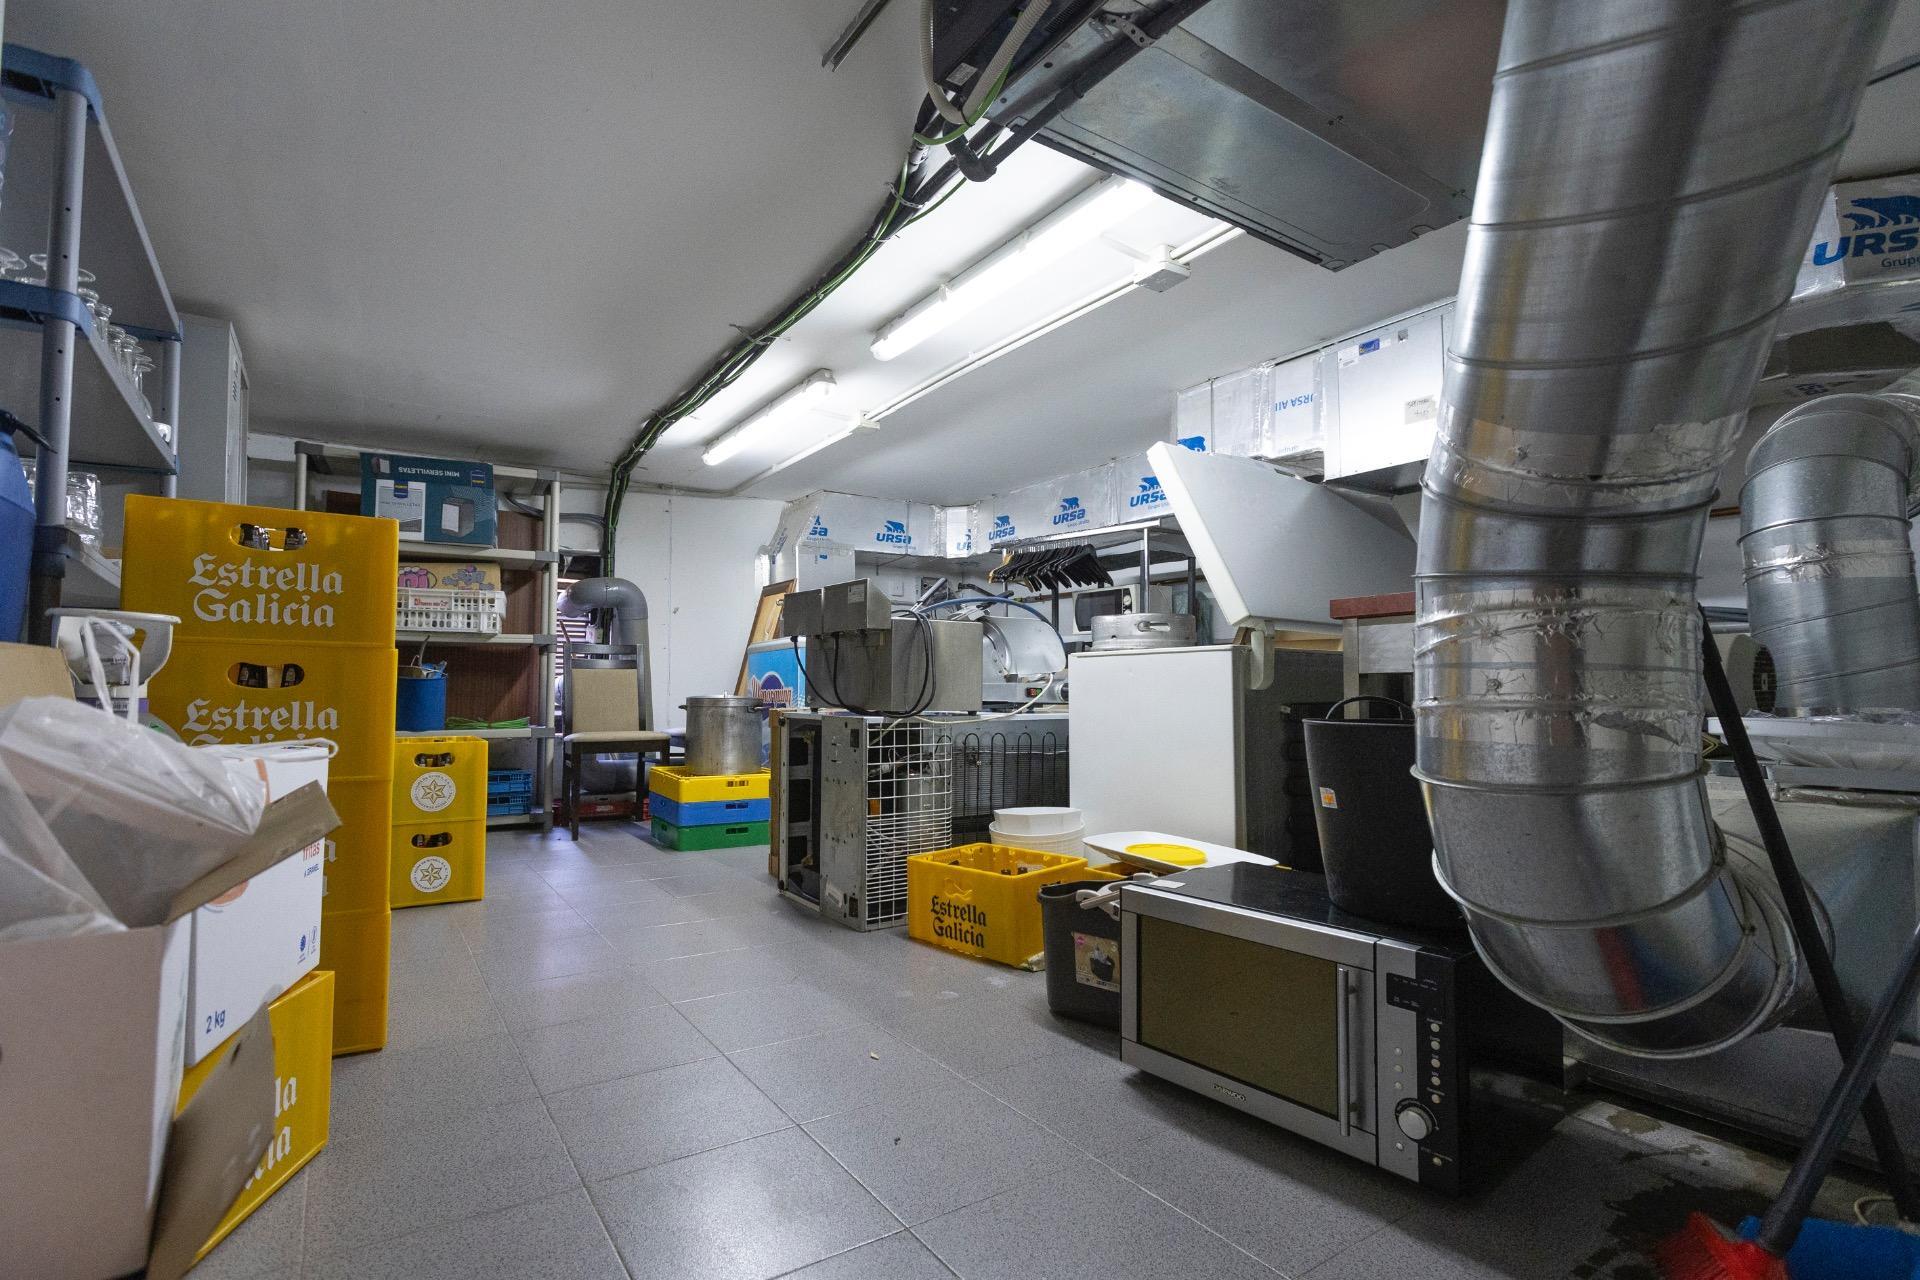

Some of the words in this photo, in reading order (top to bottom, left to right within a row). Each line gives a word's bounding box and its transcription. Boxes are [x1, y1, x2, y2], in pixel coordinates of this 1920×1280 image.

[398, 466, 444, 476] SERVILLETAS
[187, 553, 344, 595] Estrella
[193, 587, 335, 627] Galicia
[181, 698, 340, 731] Estrella
[931, 895, 986, 927] Estrella
[933, 916, 984, 948] Galicia
[206, 1015, 212, 1034] 2
[215, 1009, 226, 1029] kg
